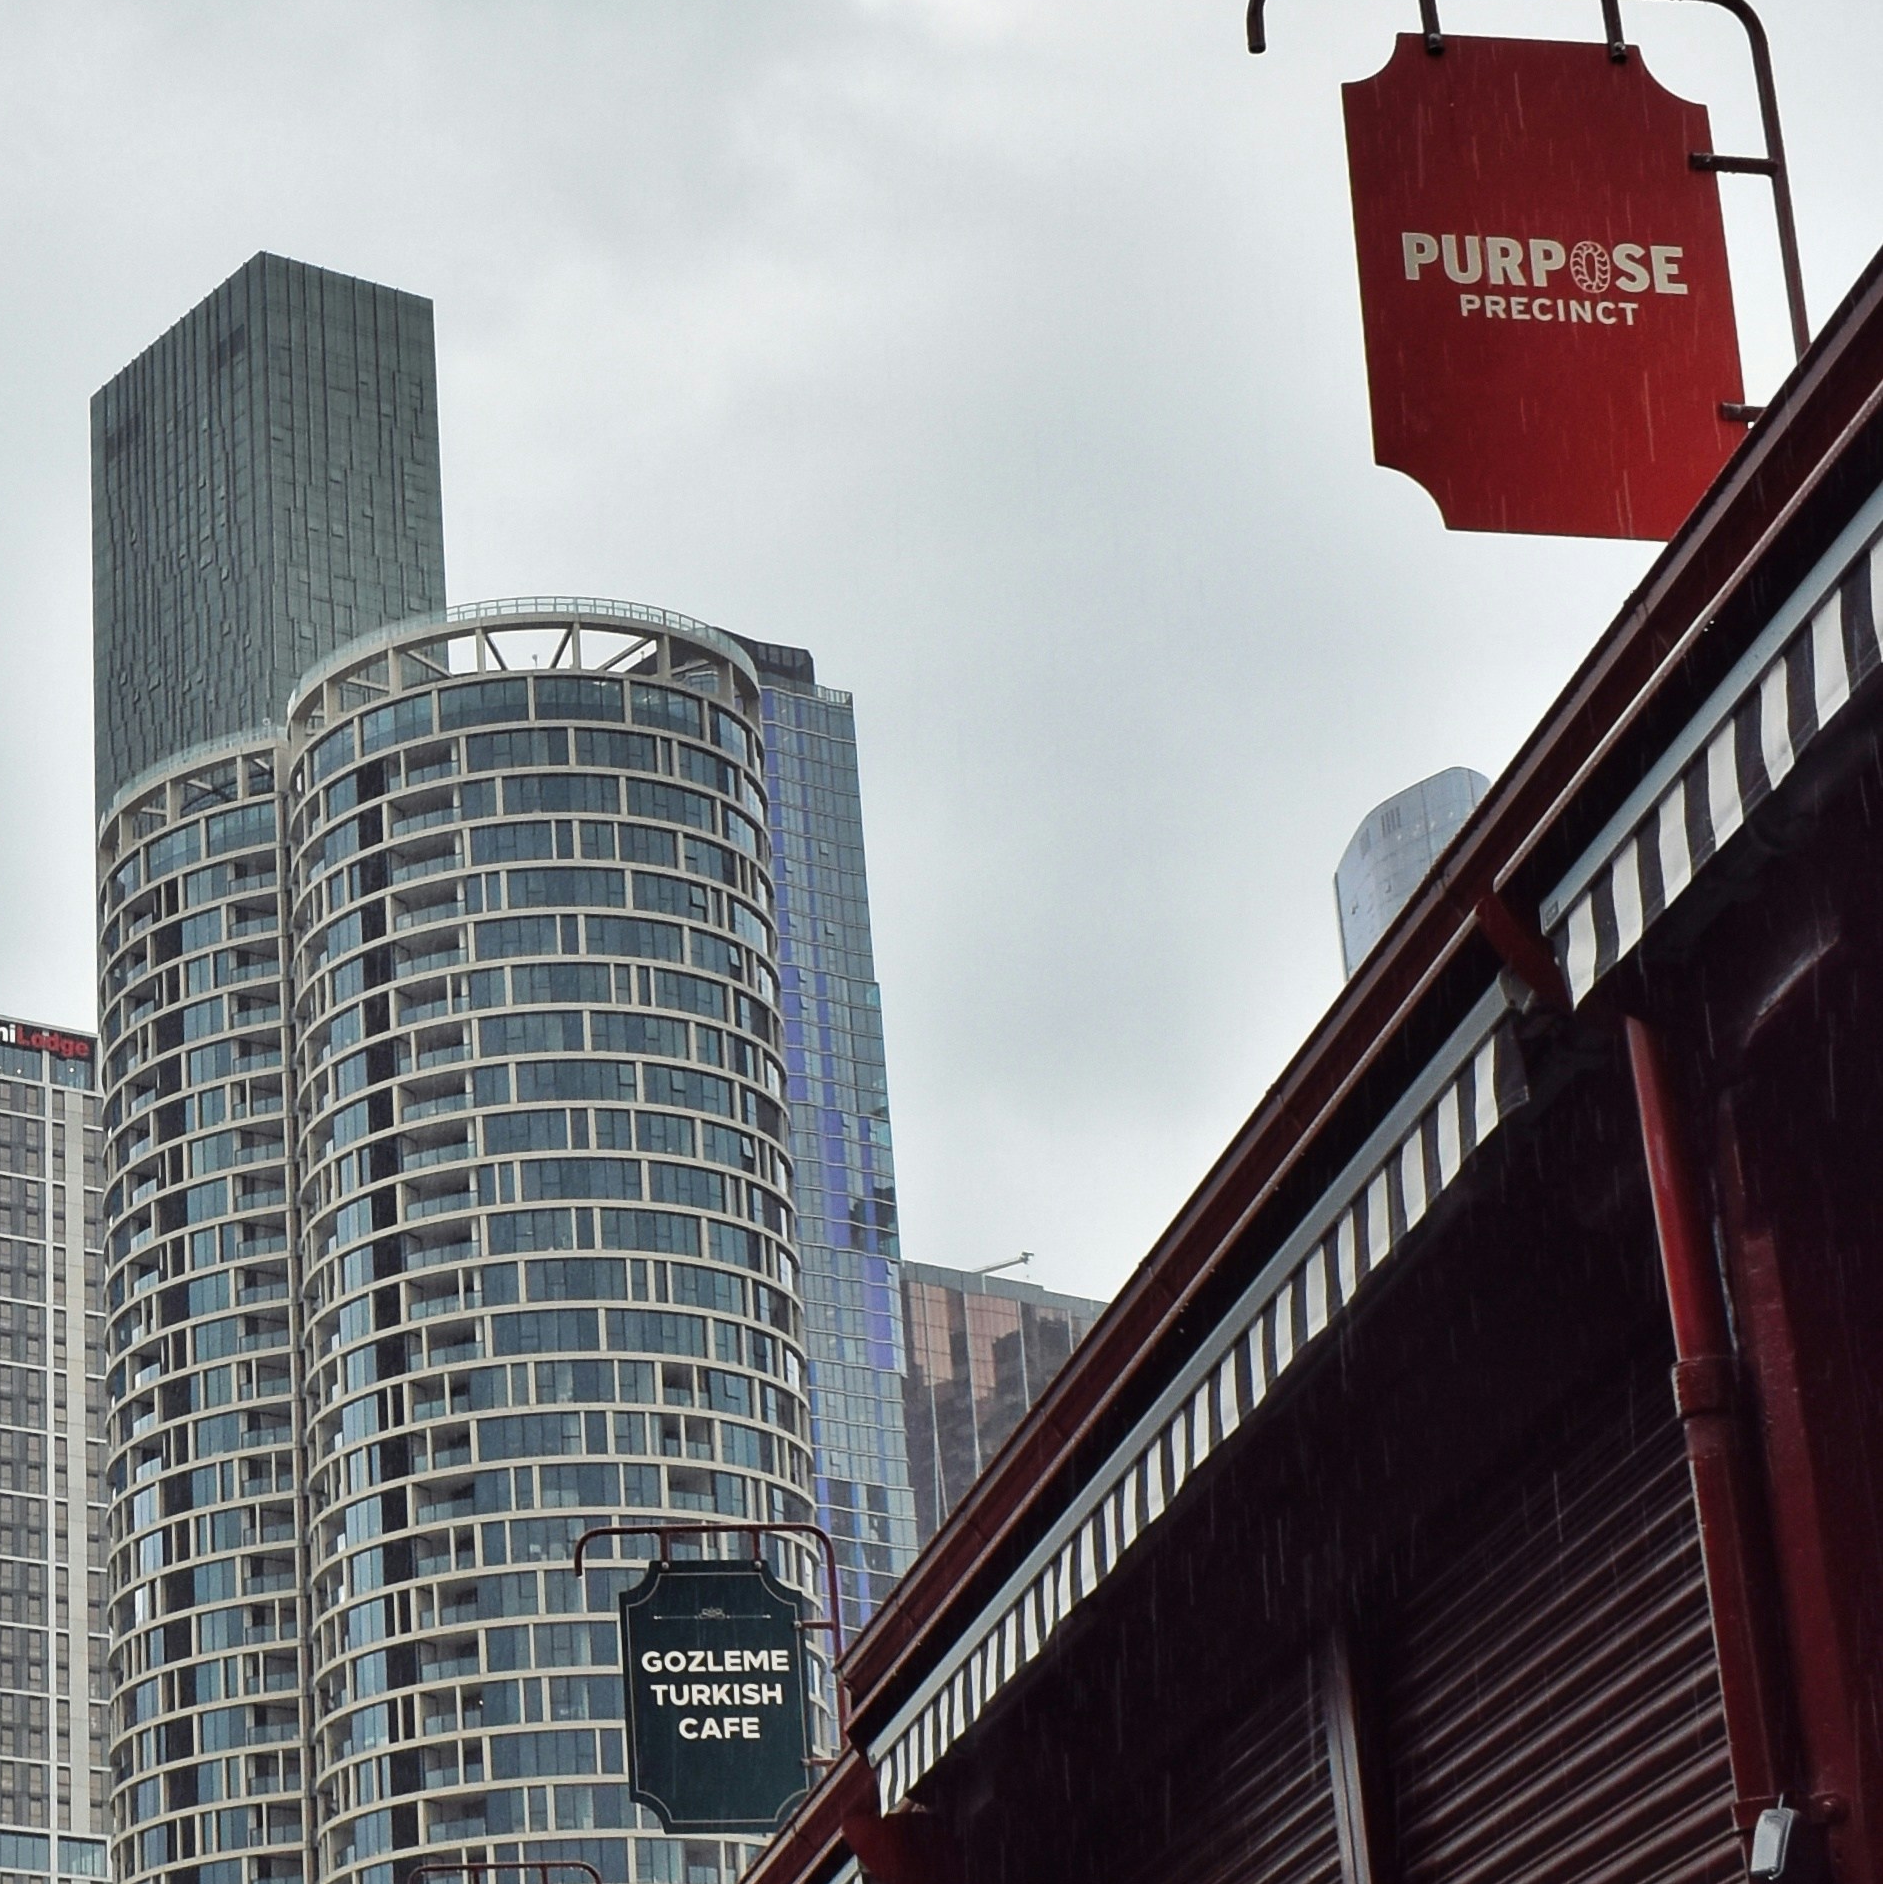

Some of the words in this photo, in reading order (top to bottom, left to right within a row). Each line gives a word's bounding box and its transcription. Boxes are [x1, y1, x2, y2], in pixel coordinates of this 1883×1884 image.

[1401, 232, 1688, 295] PURPOSE
[1460, 294, 1639, 326] PRECINCT
[641, 1650, 790, 1672] GOZLEME
[650, 1683, 783, 1706] TURKISH
[678, 1717, 761, 1739] CAFE
